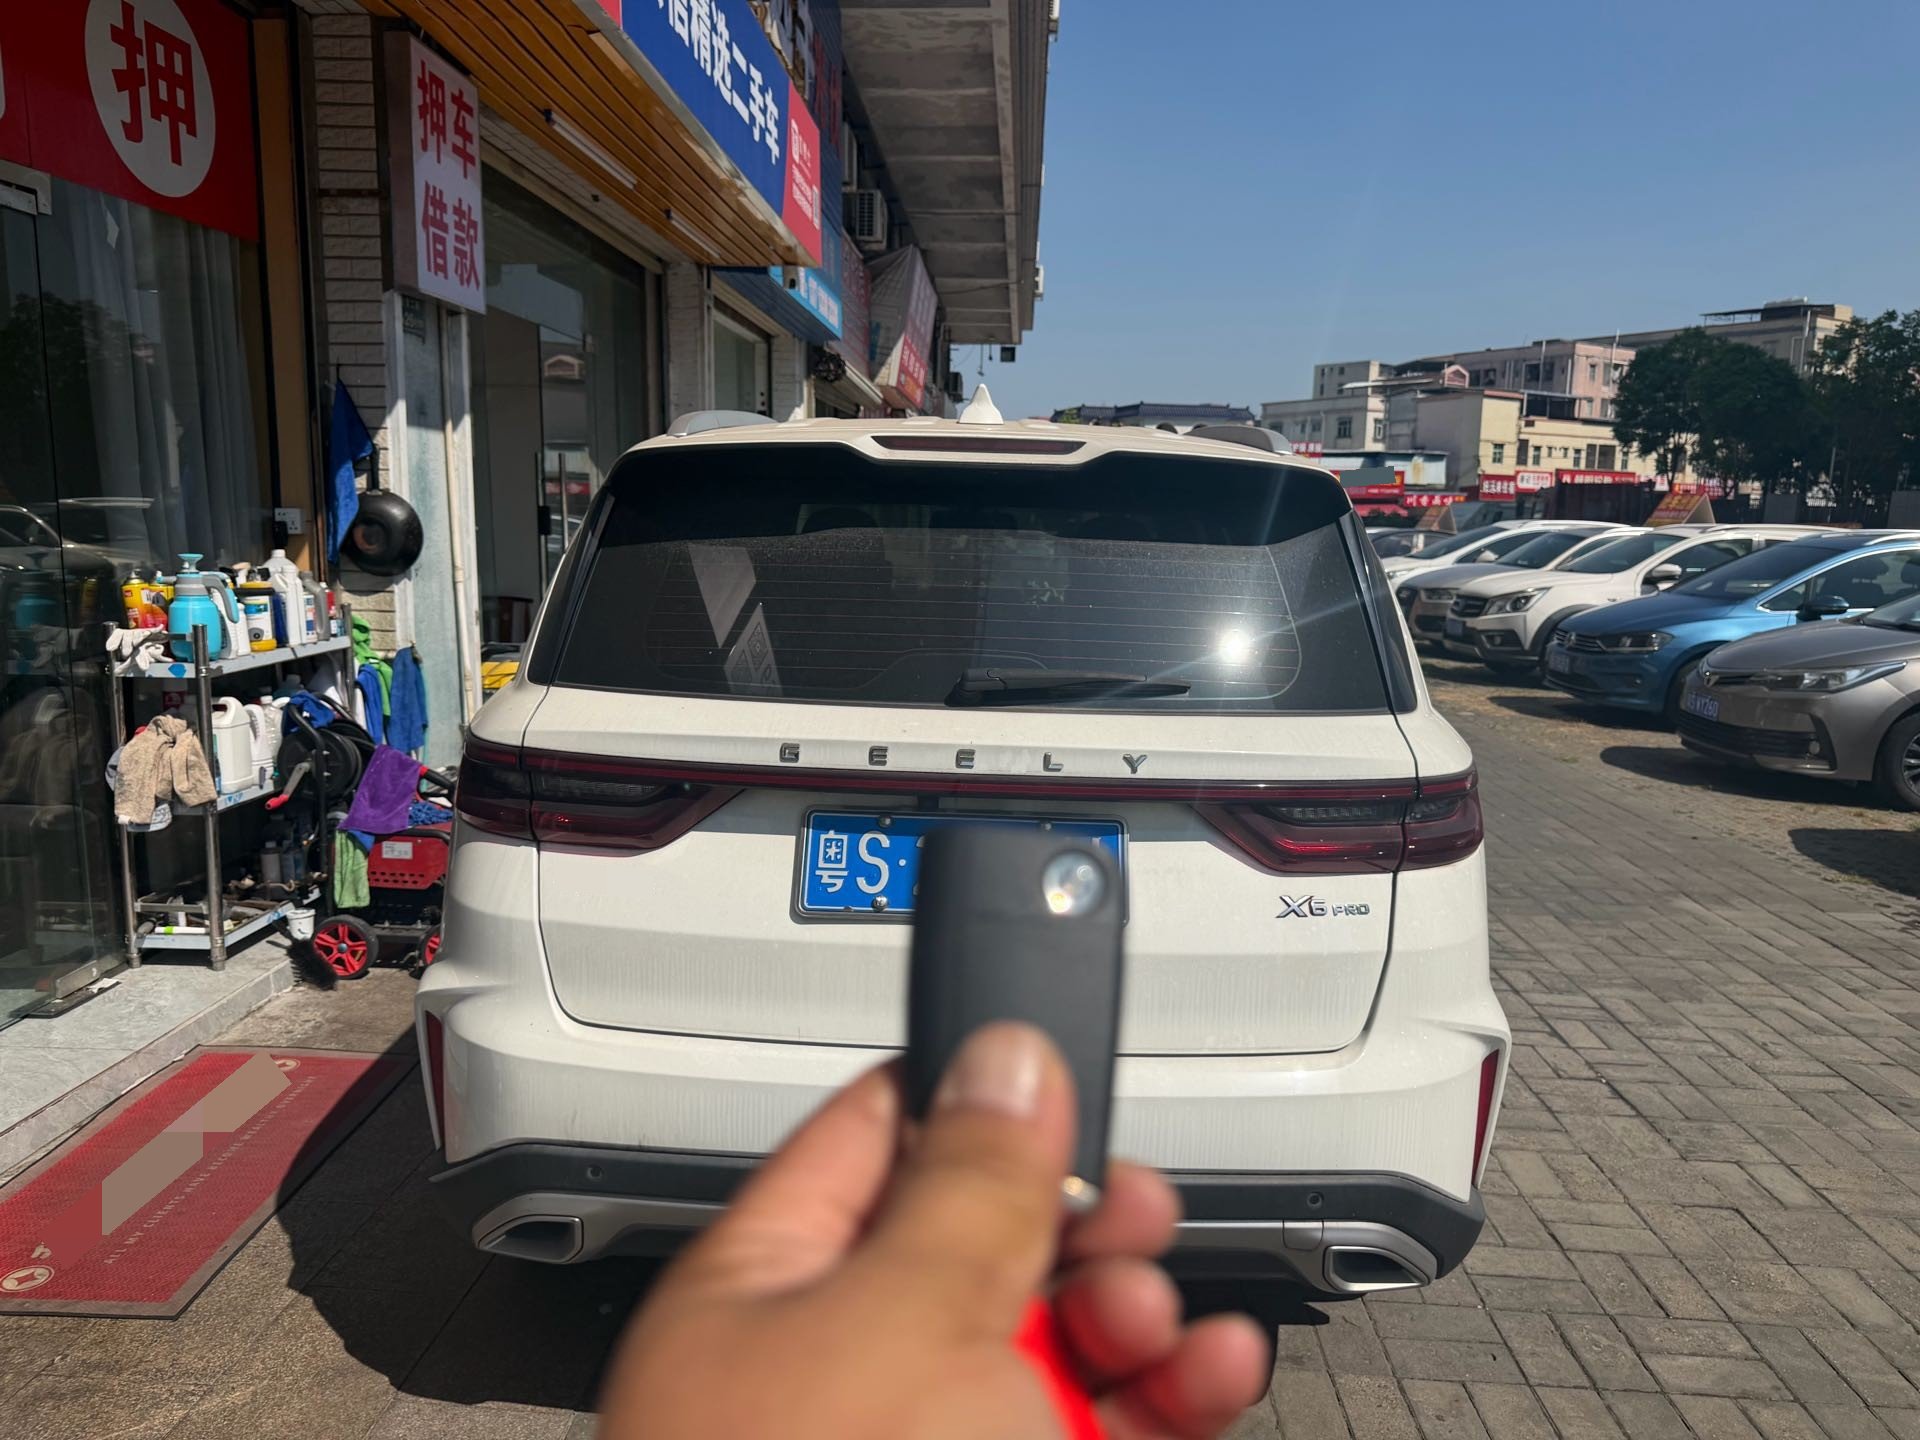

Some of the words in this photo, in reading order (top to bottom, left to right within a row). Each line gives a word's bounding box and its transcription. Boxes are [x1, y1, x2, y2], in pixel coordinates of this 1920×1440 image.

[109, 0, 197, 167] 押
[417, 59, 476, 180] 押车
[658, 0, 779, 165] 信精选二手车
[421, 180, 480, 290] 借款
[779, 742, 1148, 774] GEELY
[1275, 895, 1328, 918] X6
[1331, 903, 1370, 916] PRO
